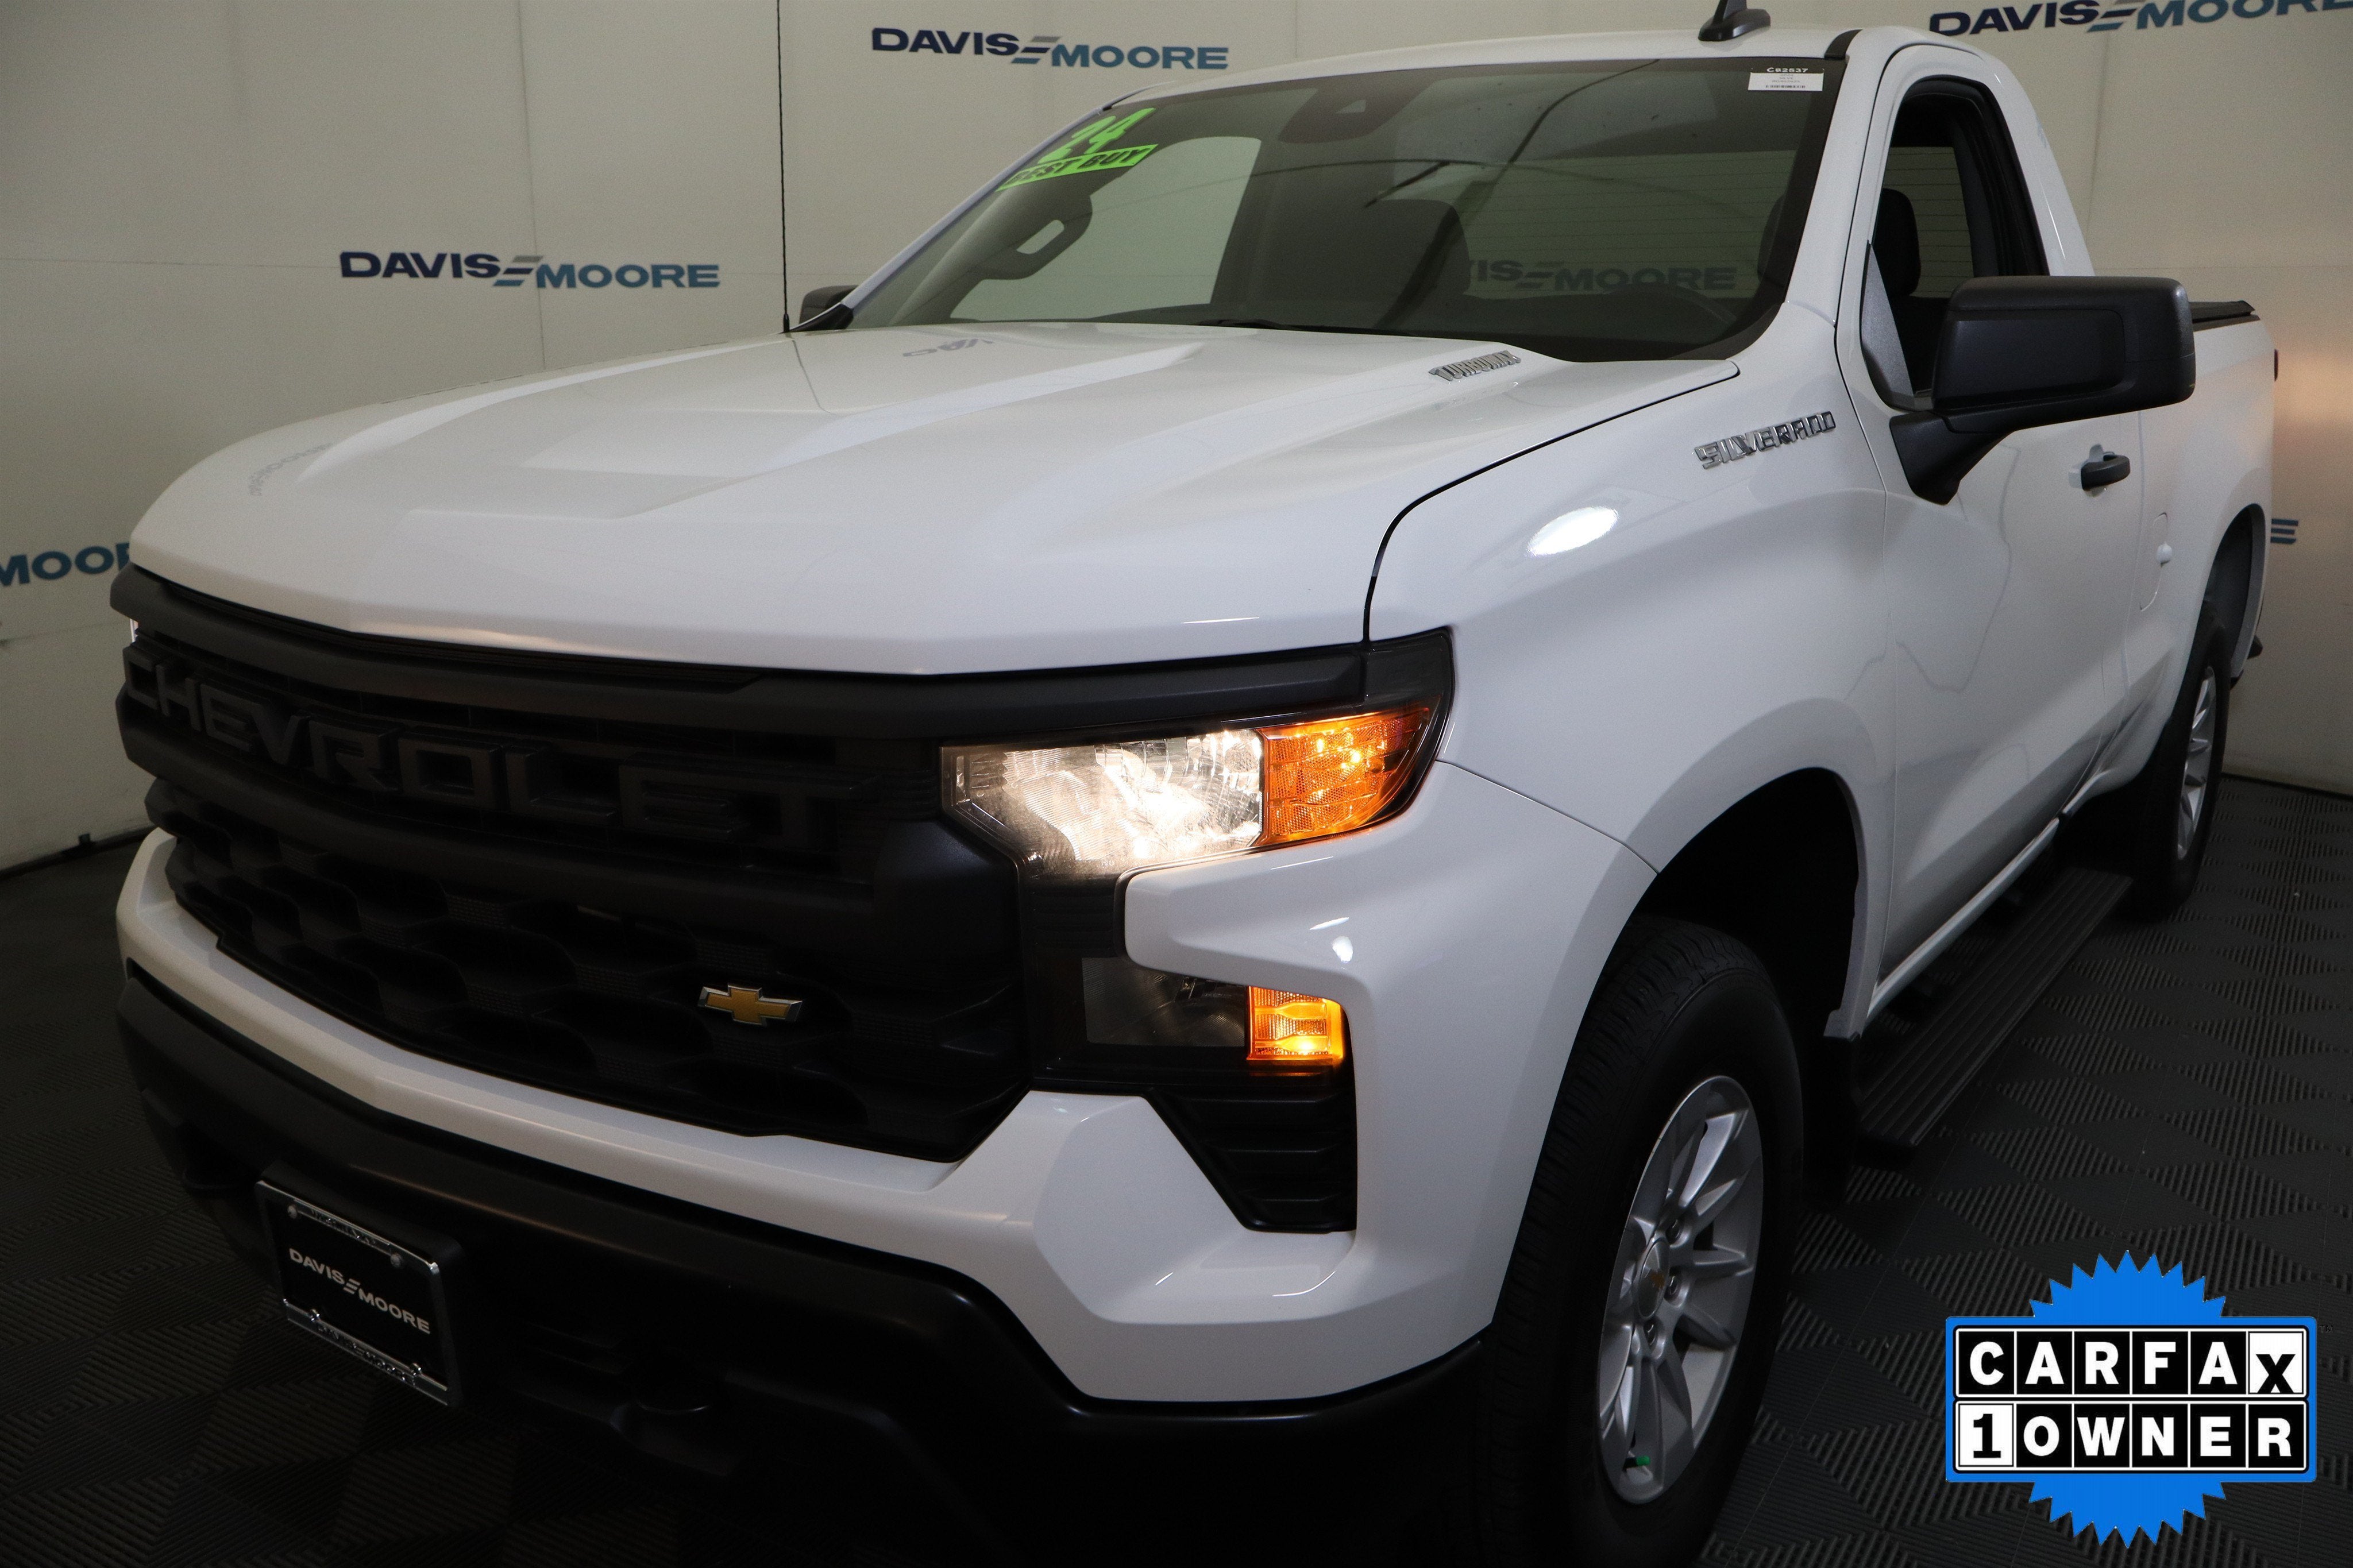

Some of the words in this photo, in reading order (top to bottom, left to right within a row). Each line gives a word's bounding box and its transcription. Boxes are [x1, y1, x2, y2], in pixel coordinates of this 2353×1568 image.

[1929, 0, 2102, 36] DAVIS
[871, 27, 1021, 56] DAVIS
[1051, 44, 1229, 70] MOORE
[1077, 148, 1151, 170] BUY
[339, 251, 500, 278] DAVIS
[535, 264, 721, 289] MOORE
[1554, 267, 1738, 291] MOORE
[1428, 350, 1522, 381] TURBOMAX
[1694, 410, 1837, 470] SILVERADO
[0, 542, 130, 587] MOO
[123, 642, 879, 851] CHEVROLET
[288, 1248, 345, 1286] DAVIS
[357, 1290, 431, 1335] MOORE
